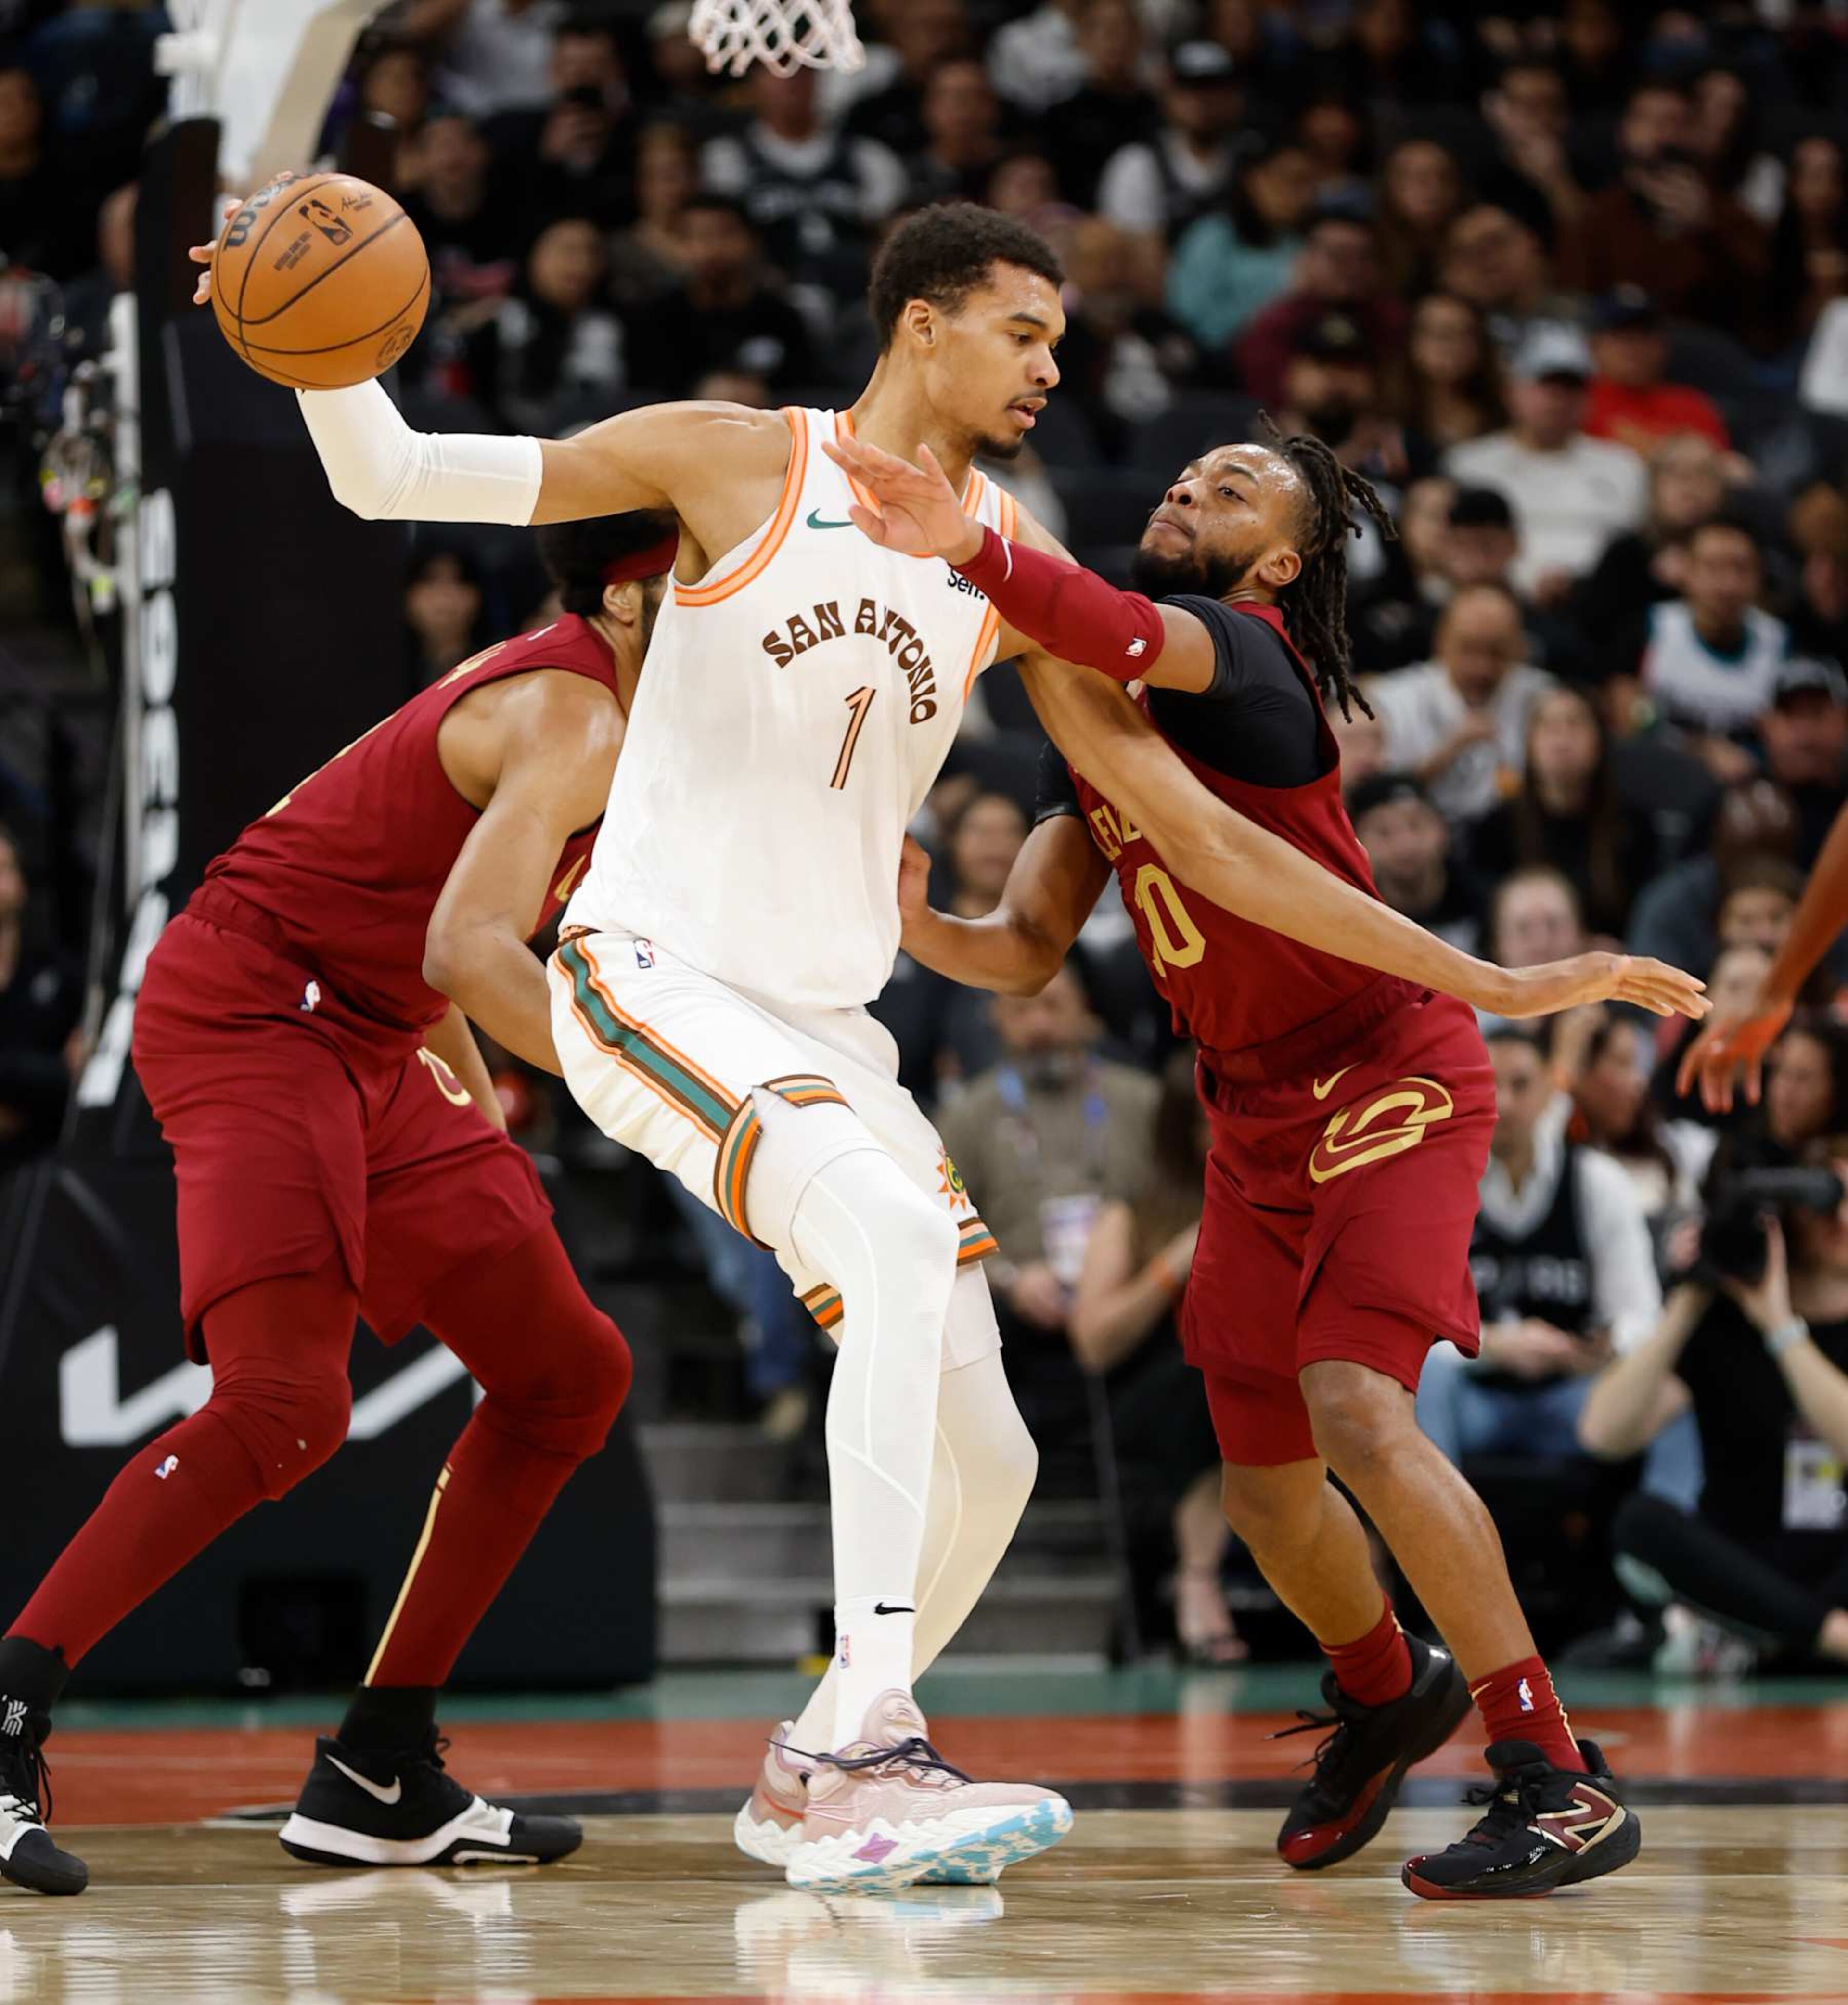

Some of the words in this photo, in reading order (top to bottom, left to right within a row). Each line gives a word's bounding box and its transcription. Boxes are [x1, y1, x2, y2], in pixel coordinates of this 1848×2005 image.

[762, 600, 846, 669] SAN
[854, 598, 937, 725] ANTONIO
[829, 686, 876, 791] 1
